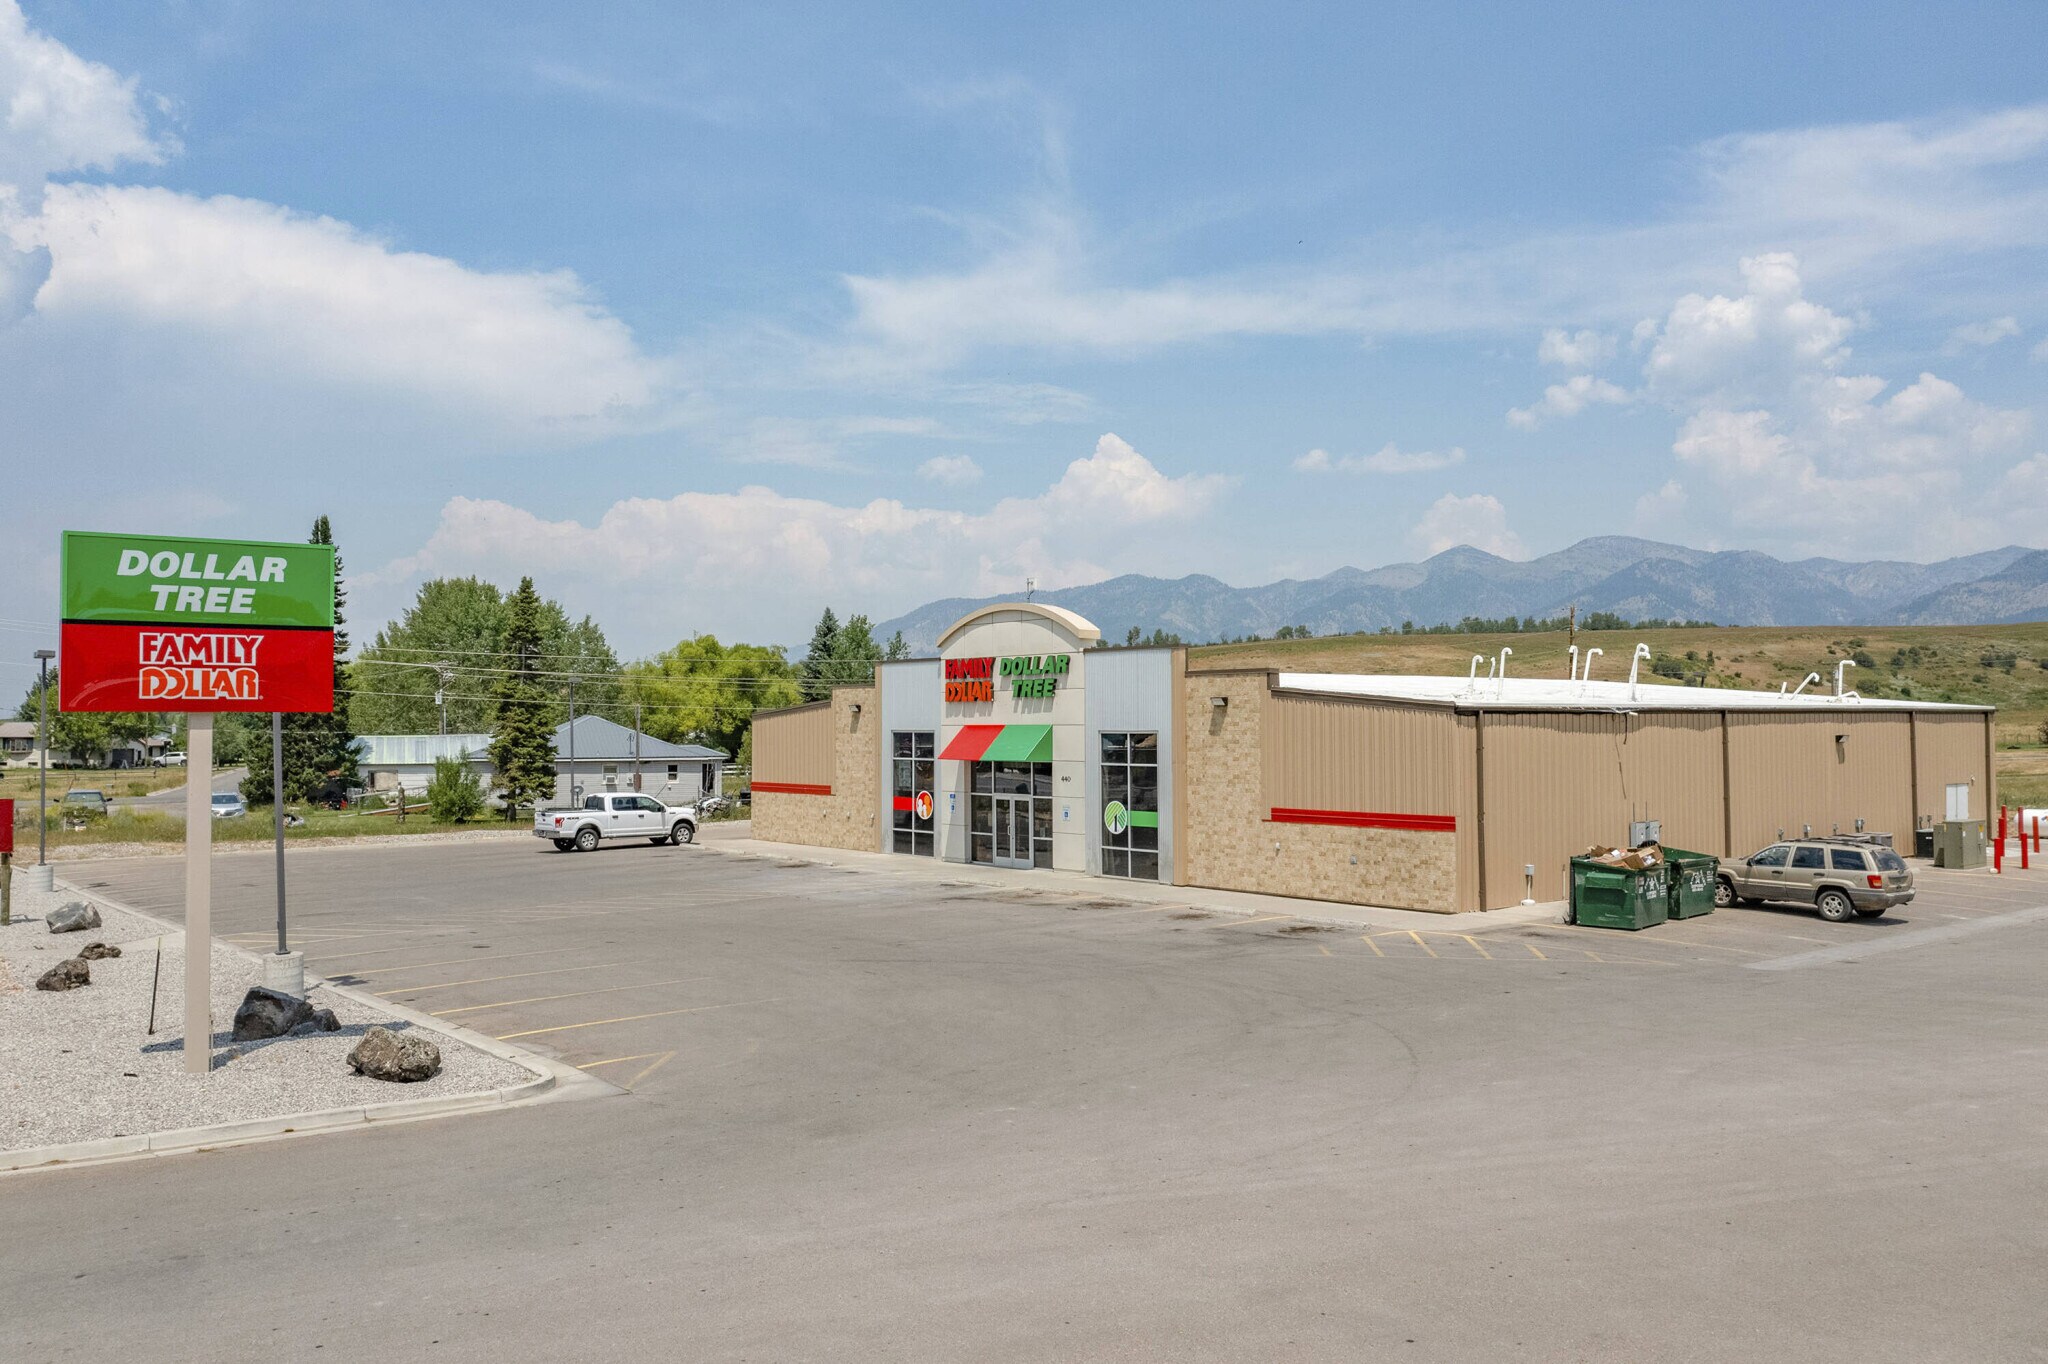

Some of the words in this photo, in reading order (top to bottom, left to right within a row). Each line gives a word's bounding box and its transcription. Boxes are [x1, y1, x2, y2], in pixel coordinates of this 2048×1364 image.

[117, 550, 287, 582] DOLLAR
[150, 585, 256, 614] TREE
[139, 632, 264, 666] FAMILY
[945, 657, 995, 679] FAMILY
[999, 655, 1069, 676] DOLLAR
[139, 667, 259, 700] DOLLAR
[945, 681, 993, 702] DOLLAR
[1012, 678, 1056, 698] TREE
